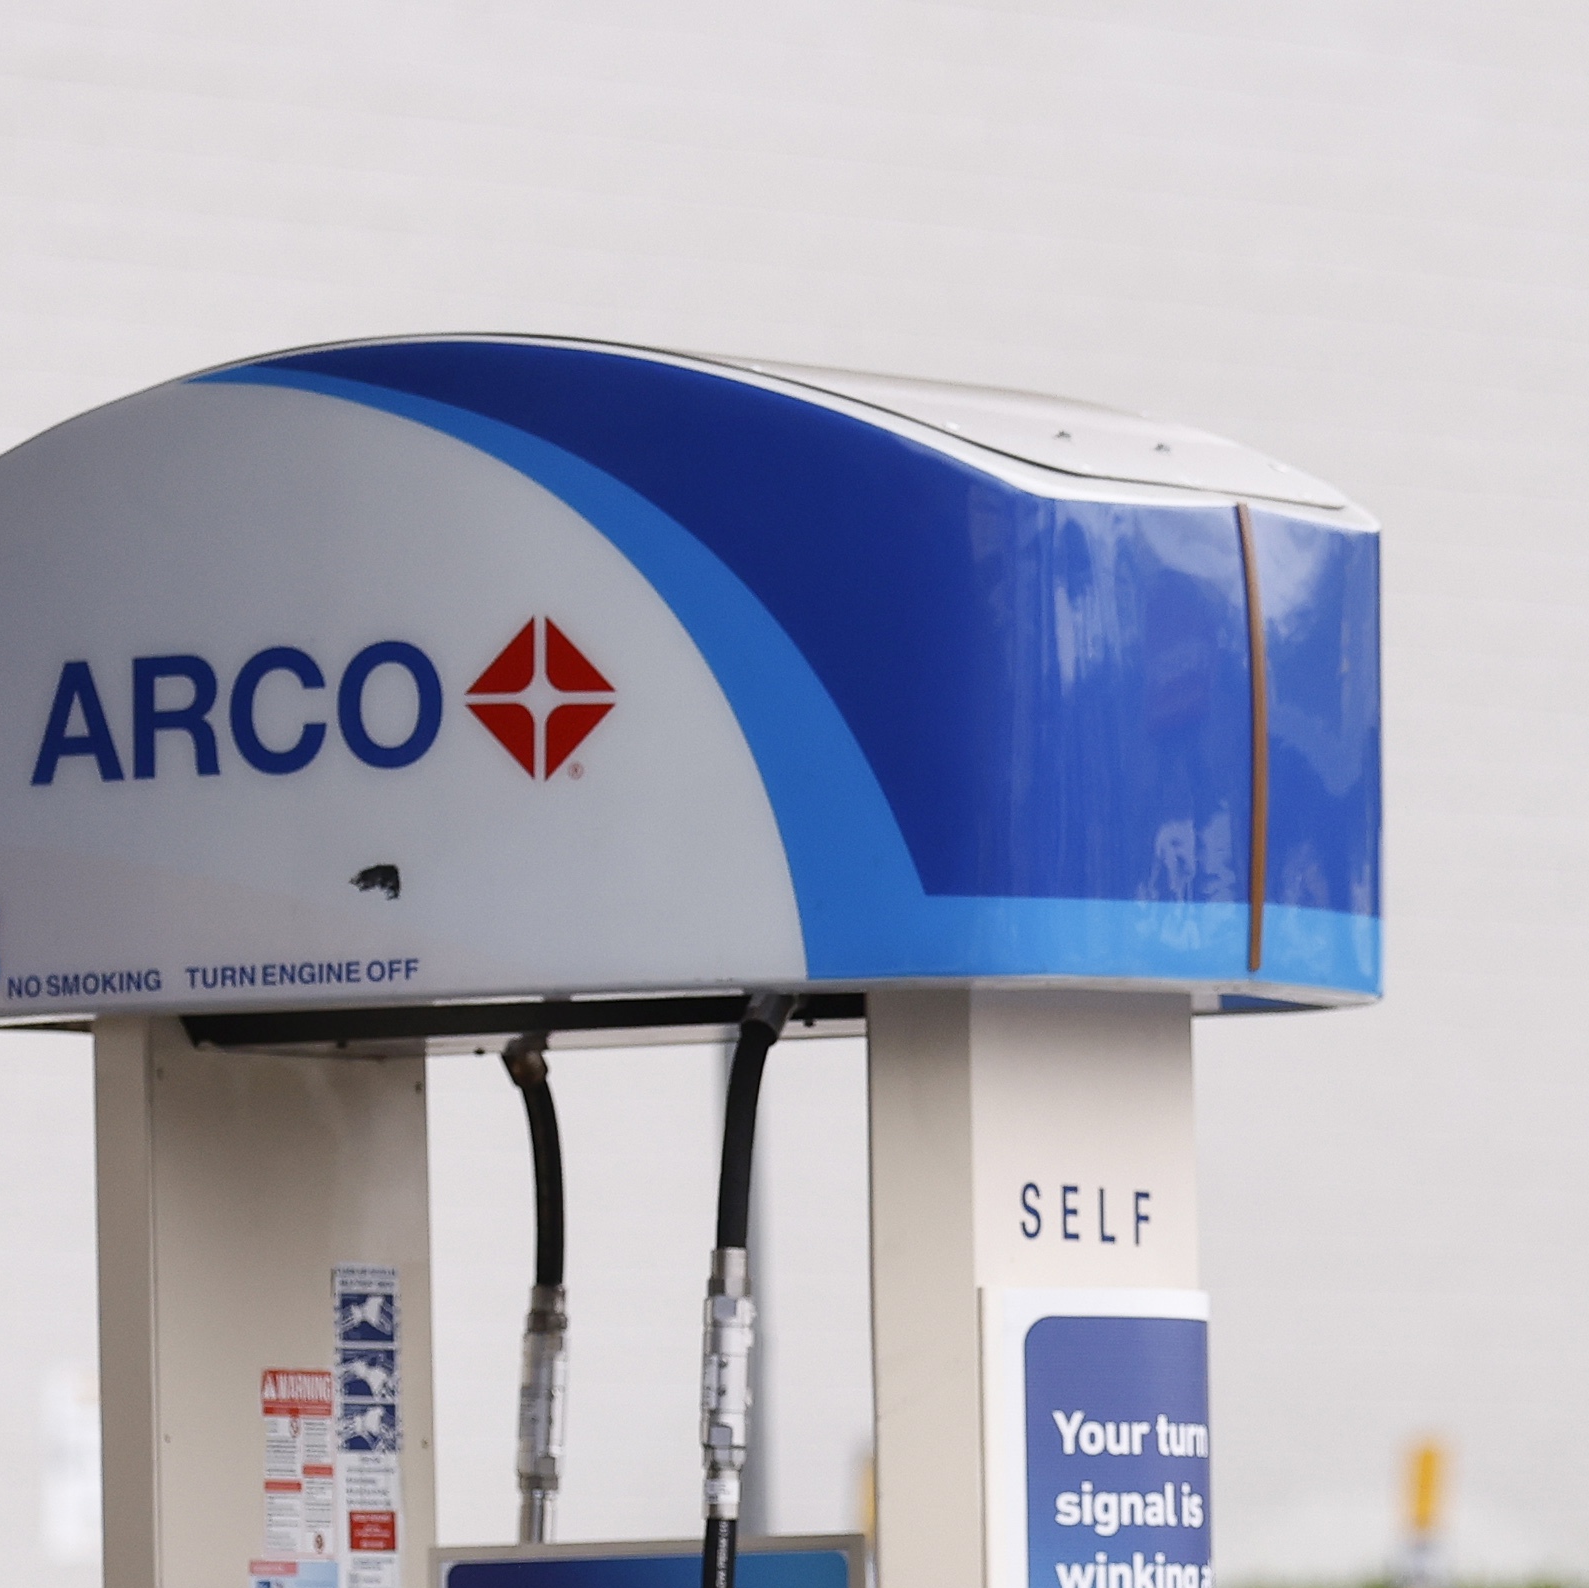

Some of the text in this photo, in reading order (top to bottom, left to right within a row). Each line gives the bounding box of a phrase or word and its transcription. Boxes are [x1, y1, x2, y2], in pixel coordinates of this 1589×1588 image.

[29, 640, 443, 786] ARCO
[8, 969, 162, 999] NO SMOKING
[185, 959, 419, 990] TURN ENGINE OFF
[1020, 1181, 1150, 1246] SELF
[1052, 1410, 1151, 1456] Your
[1055, 1480, 1204, 1537] signal is
